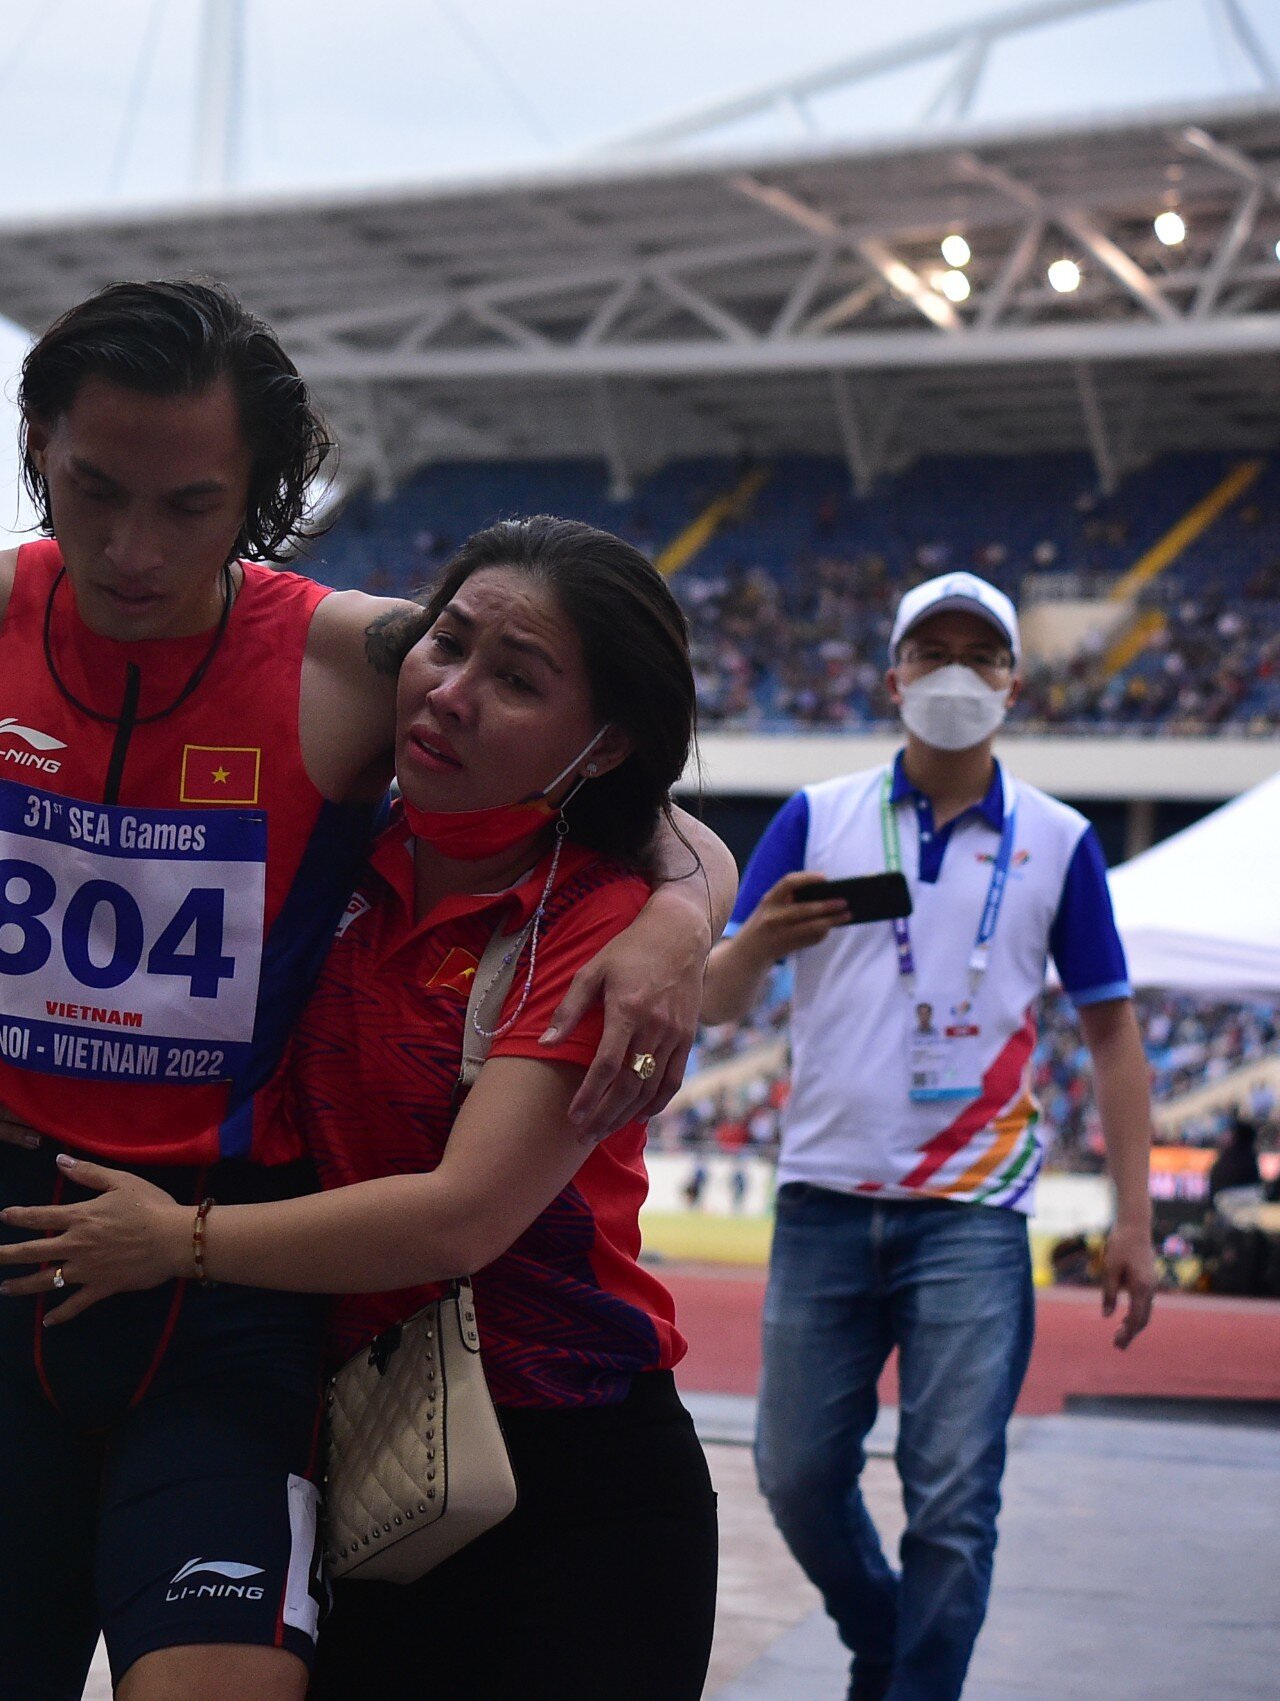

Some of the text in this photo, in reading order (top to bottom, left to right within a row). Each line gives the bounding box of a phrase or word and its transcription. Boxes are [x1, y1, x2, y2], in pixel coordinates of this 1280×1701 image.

[68, 806, 111, 847] SEA
[119, 815, 207, 852] Games
[45, 1000, 144, 1028] VIETNAM
[53, 1033, 160, 1077] VIETNAM
[164, 1047, 225, 1078] 2022
[165, 1583, 265, 1602] LI-NING
